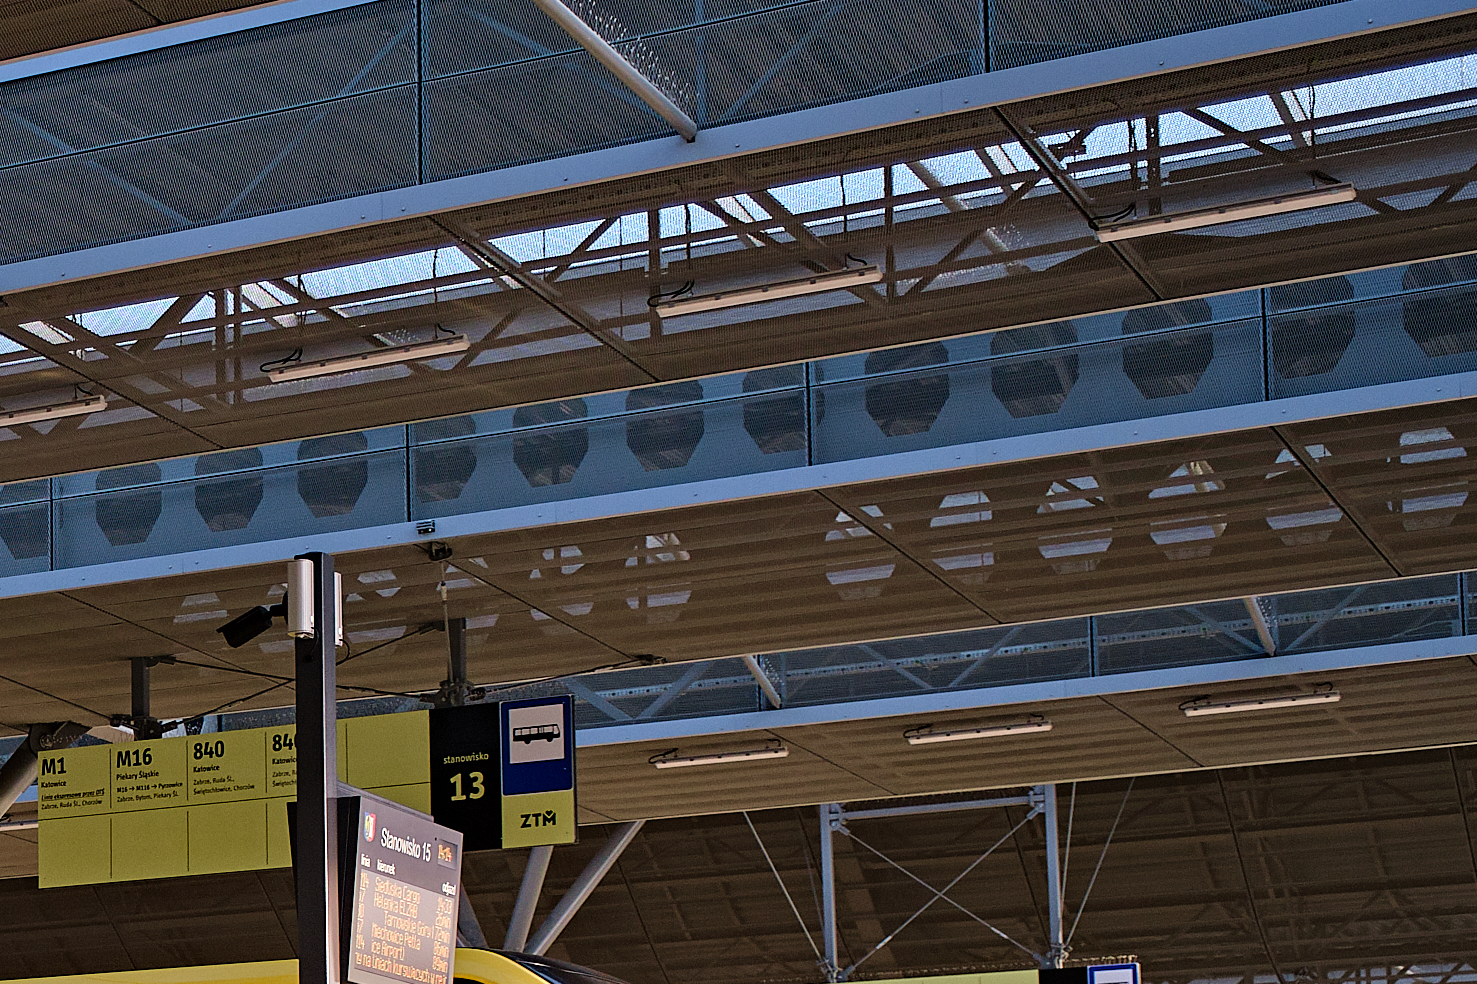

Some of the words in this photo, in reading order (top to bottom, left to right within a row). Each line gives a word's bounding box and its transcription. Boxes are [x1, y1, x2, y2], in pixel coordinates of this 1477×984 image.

[116, 748, 152, 768] M16
[194, 740, 224, 760] 840
[444, 752, 489, 764] stanowisko
[41, 757, 66, 776] M1
[193, 764, 220, 773] Katowice
[272, 756, 296, 764] Katowic
[40, 780, 66, 788] Katowice
[116, 772, 138, 780] Piekary
[138, 770, 160, 778] Śląskie
[450, 772, 485, 802] 13
[520, 810, 556, 828] ZTM
[381, 828, 421, 859] Stanowisko
[422, 842, 432, 862] 15
